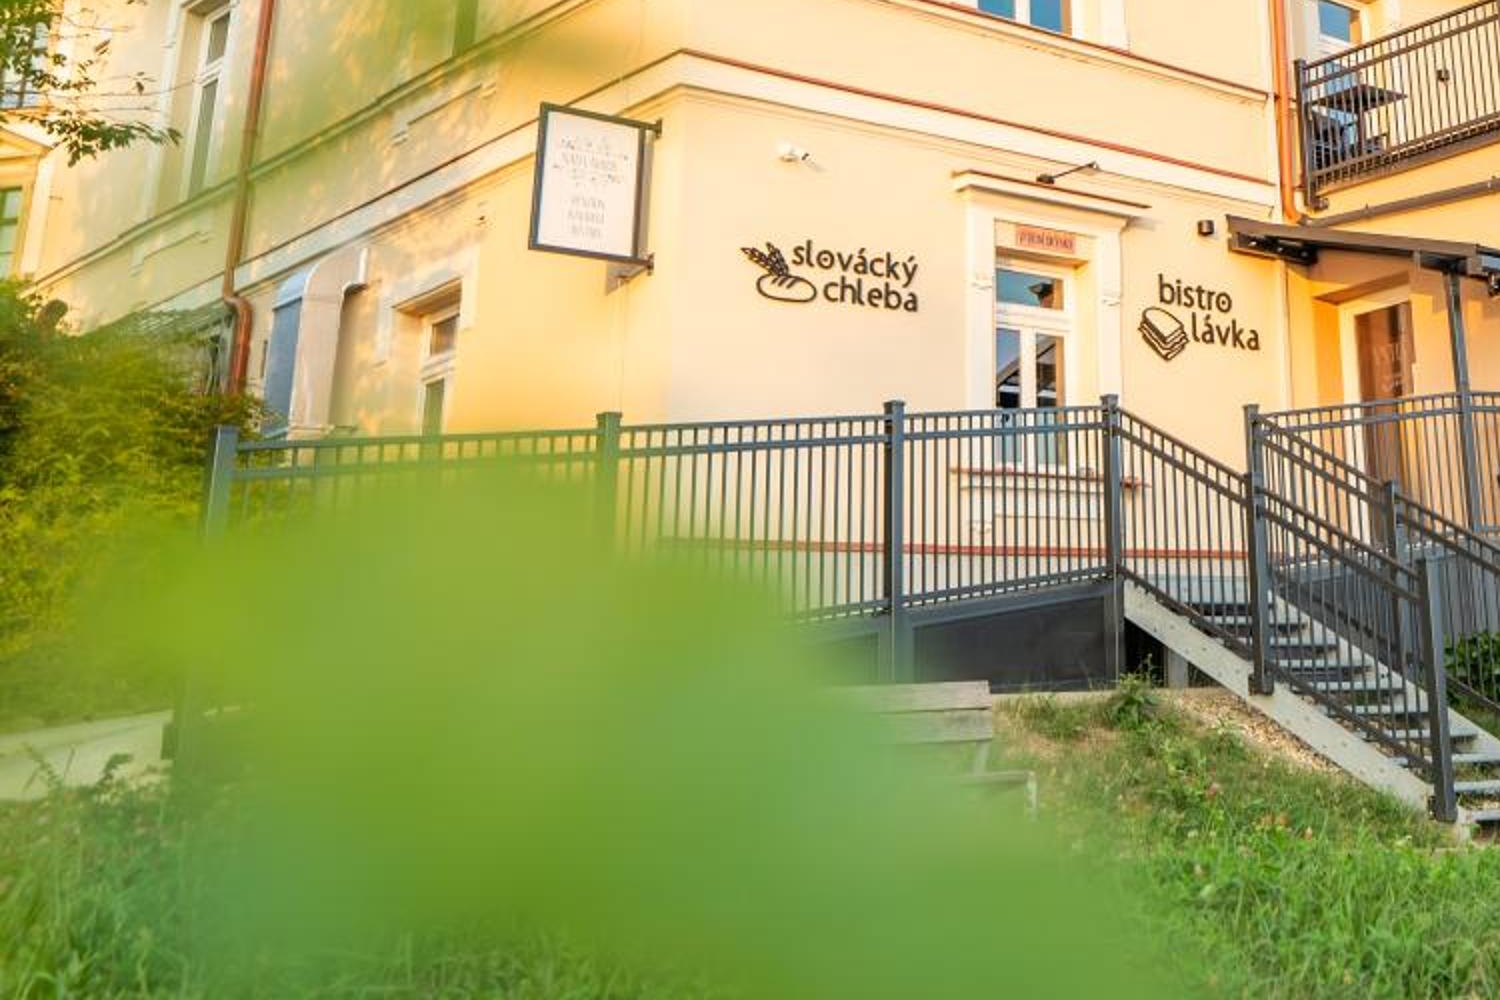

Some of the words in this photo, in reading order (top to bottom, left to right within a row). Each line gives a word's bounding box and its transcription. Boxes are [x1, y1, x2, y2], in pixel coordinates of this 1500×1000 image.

[792, 239, 918, 288] slovácký
[823, 275, 918, 312] chleba
[1158, 273, 1232, 313] bistro
[1191, 311, 1260, 351] lávka
